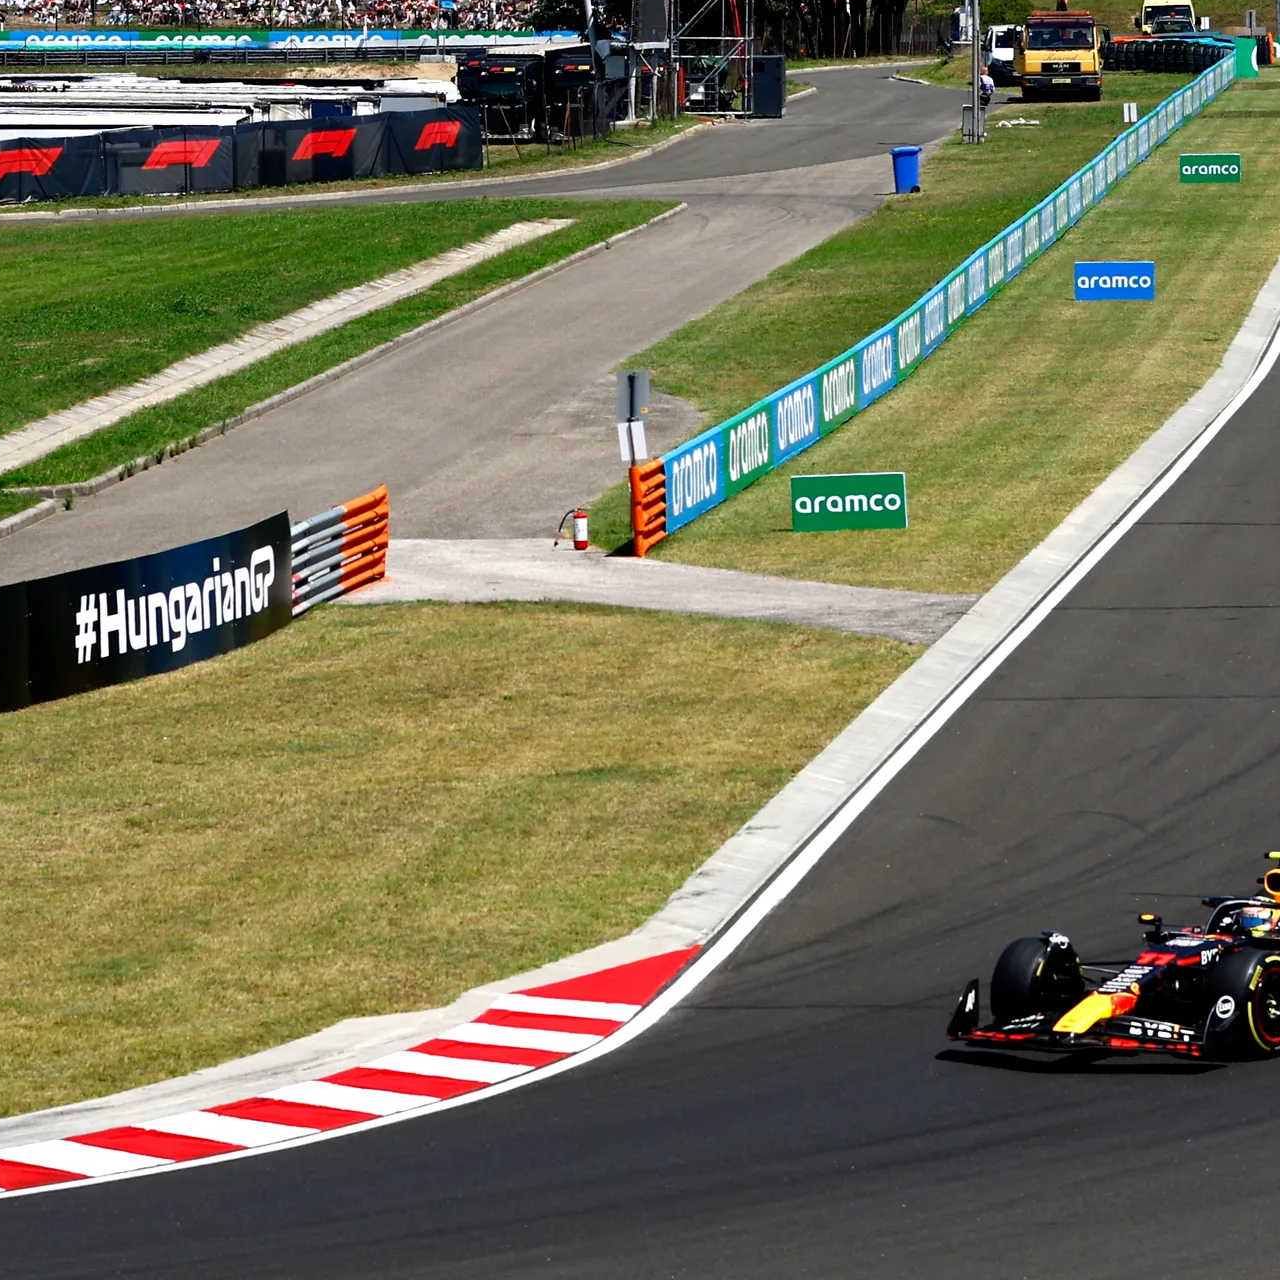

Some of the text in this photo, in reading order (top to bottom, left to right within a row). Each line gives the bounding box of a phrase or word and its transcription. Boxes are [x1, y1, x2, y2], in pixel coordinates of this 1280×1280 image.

[1182, 165, 1239, 175] aramco
[1077, 272, 1151, 290] aramco
[777, 384, 815, 450] aramco
[822, 359, 855, 422] aramco
[672, 440, 717, 516] aramco
[729, 412, 769, 482] aramco
[795, 493, 901, 514] aramco
[75, 545, 274, 665] #HungarianGP
